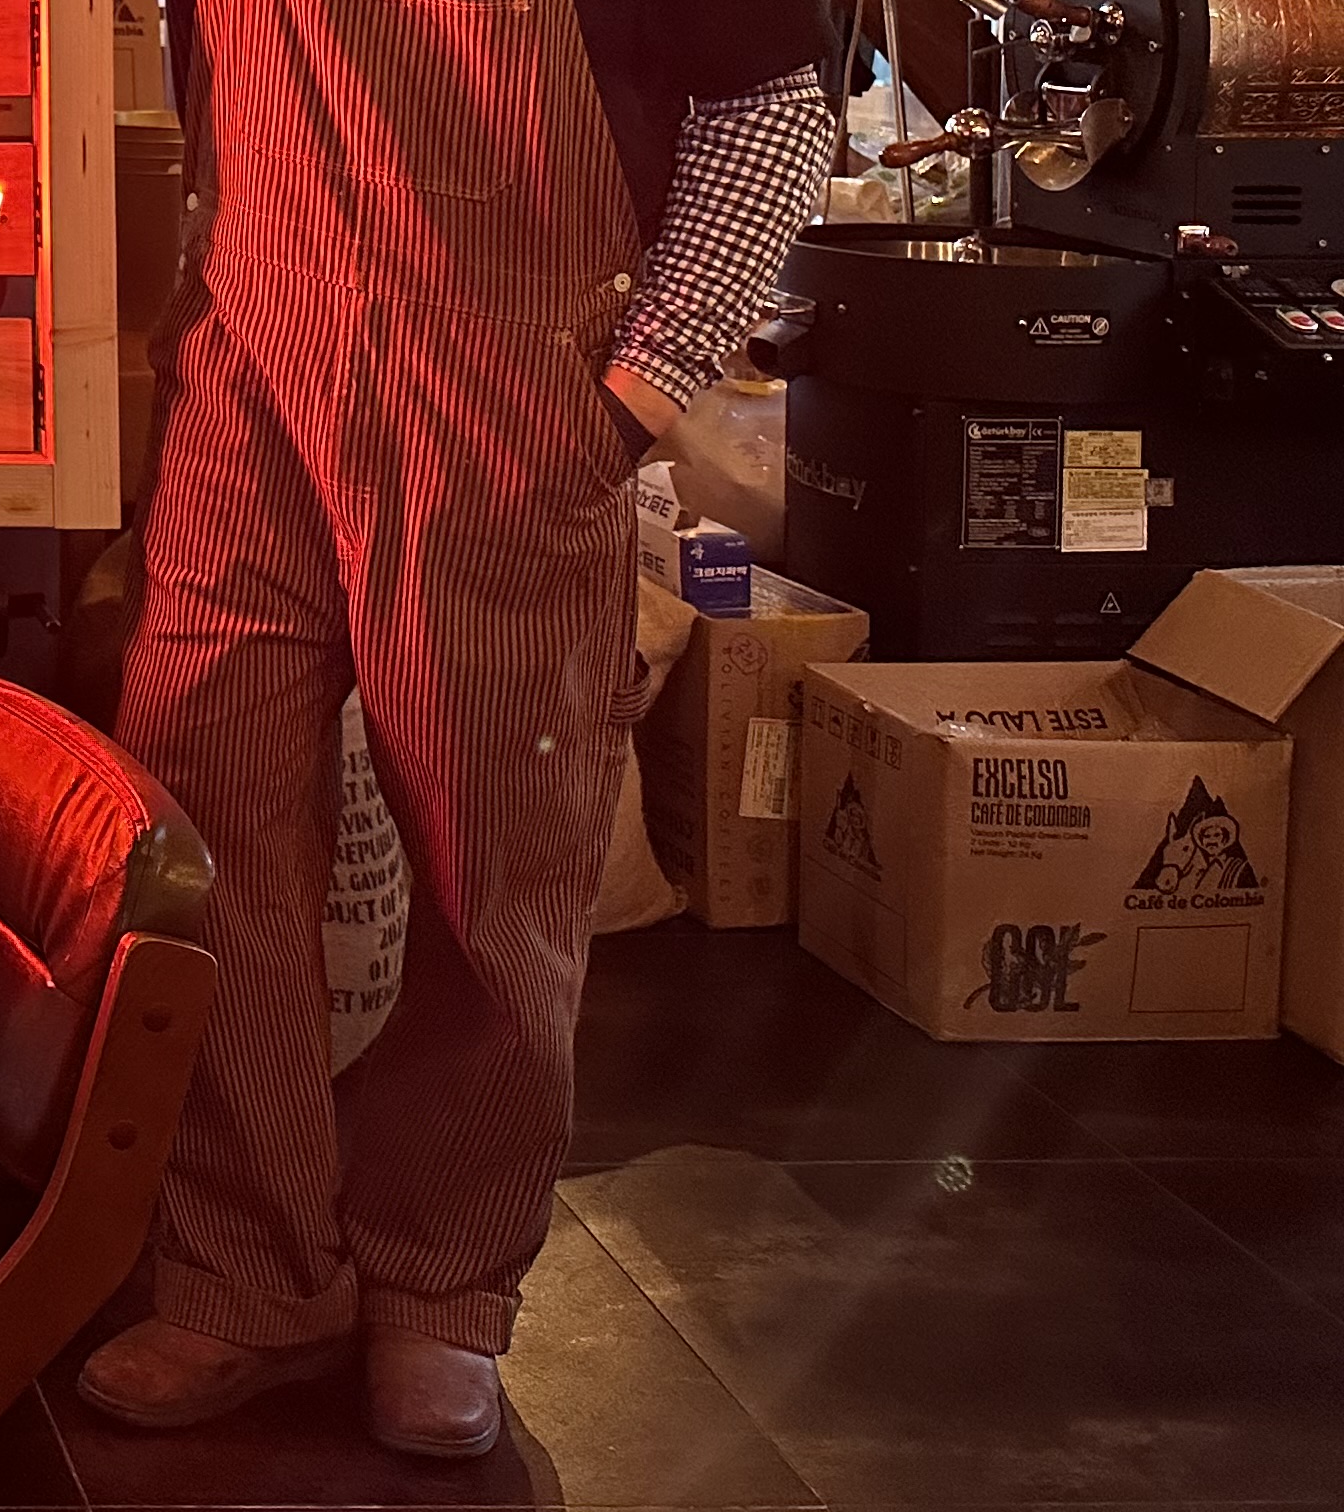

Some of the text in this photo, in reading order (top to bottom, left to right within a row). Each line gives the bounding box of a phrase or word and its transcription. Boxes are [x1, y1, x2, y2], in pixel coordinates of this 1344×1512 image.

[1050, 314, 1091, 324] CAUTION
[1046, 707, 1109, 731] ESTE
[971, 757, 1069, 800] EXCELSO
[1005, 803, 1022, 826] DE
[1023, 804, 1091, 828] COLOMBIA
[1124, 892, 1265, 910] Café de Colombia
